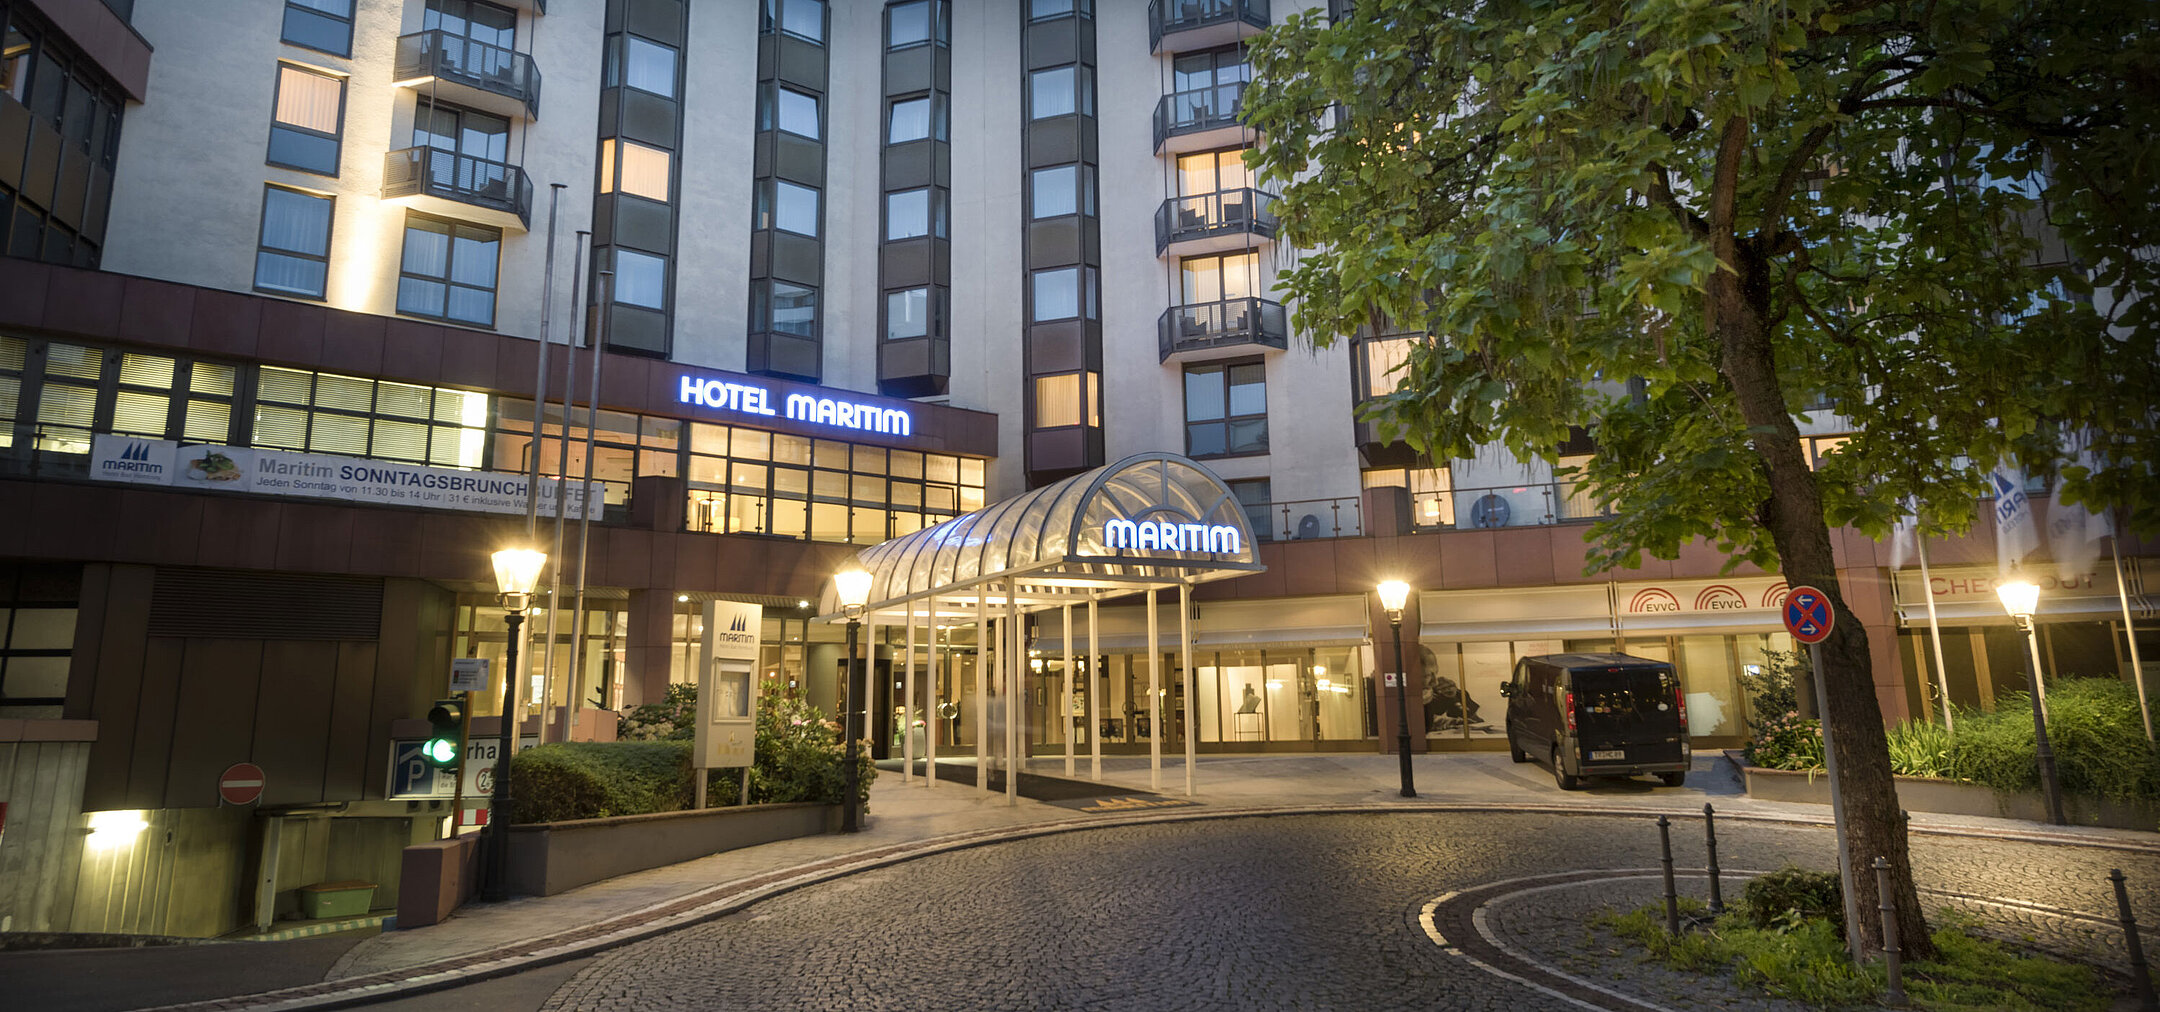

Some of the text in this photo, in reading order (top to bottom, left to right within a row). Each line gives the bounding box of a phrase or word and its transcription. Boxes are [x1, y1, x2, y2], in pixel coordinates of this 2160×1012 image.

[680, 375, 911, 436] HOTEL MARITIM
[102, 460, 163, 474] MARITIM
[259, 458, 333, 478] Maritim
[256, 477, 290, 488] Jeden
[292, 479, 337, 492] Sonntag
[339, 485, 358, 494] von
[361, 486, 389, 497] 11.30
[390, 488, 405, 498] bis
[409, 490, 420, 499] 14
[422, 491, 440, 501] Uhr
[448, 493, 460, 503] 31
[471, 495, 511, 507] inklusive
[1104, 518, 1241, 555] MARITIM
[1646, 602, 1677, 613] EVVC
[1711, 600, 1743, 610] EVVC
[719, 632, 755, 644] MARITIM
[407, 759, 425, 792] P
